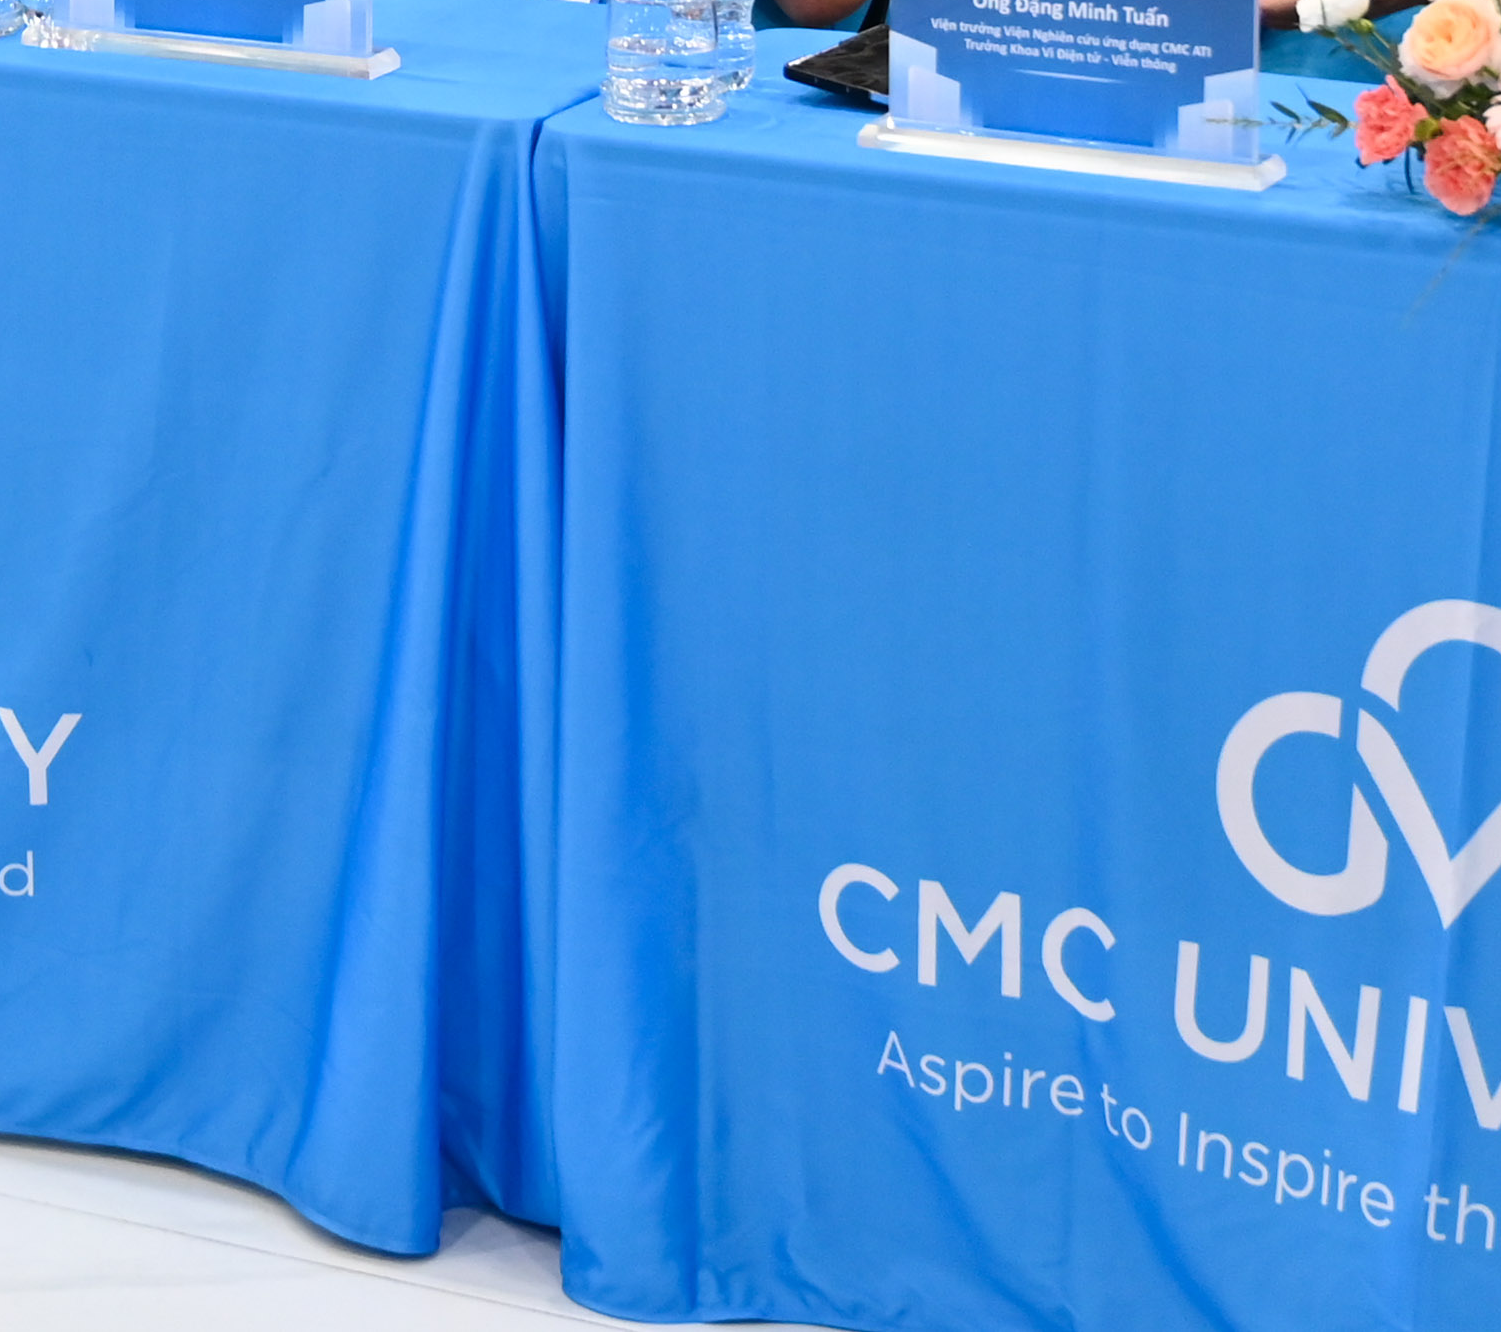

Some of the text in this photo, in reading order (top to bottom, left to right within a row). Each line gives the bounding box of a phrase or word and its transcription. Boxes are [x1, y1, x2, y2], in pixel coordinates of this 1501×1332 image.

[1067, 0, 1118, 23] Minh
[1121, 5, 1170, 29] Tuấn
[930, 17, 957, 32] Viện
[1002, 24, 1030, 39] Viện
[1032, 27, 1075, 45] Nghiên
[1076, 31, 1101, 48] cứu
[1102, 34, 1128, 51] ứng
[1128, 37, 1160, 56] dụng
[1161, 41, 1191, 57] CMC
[1009, 42, 1041, 59] Khoa
[817, 862, 1117, 1023] CMC
[875, 1027, 1086, 1119] Aspire
[1097, 1081, 1153, 1150] to
[1176, 1110, 1395, 1228] Inspire
